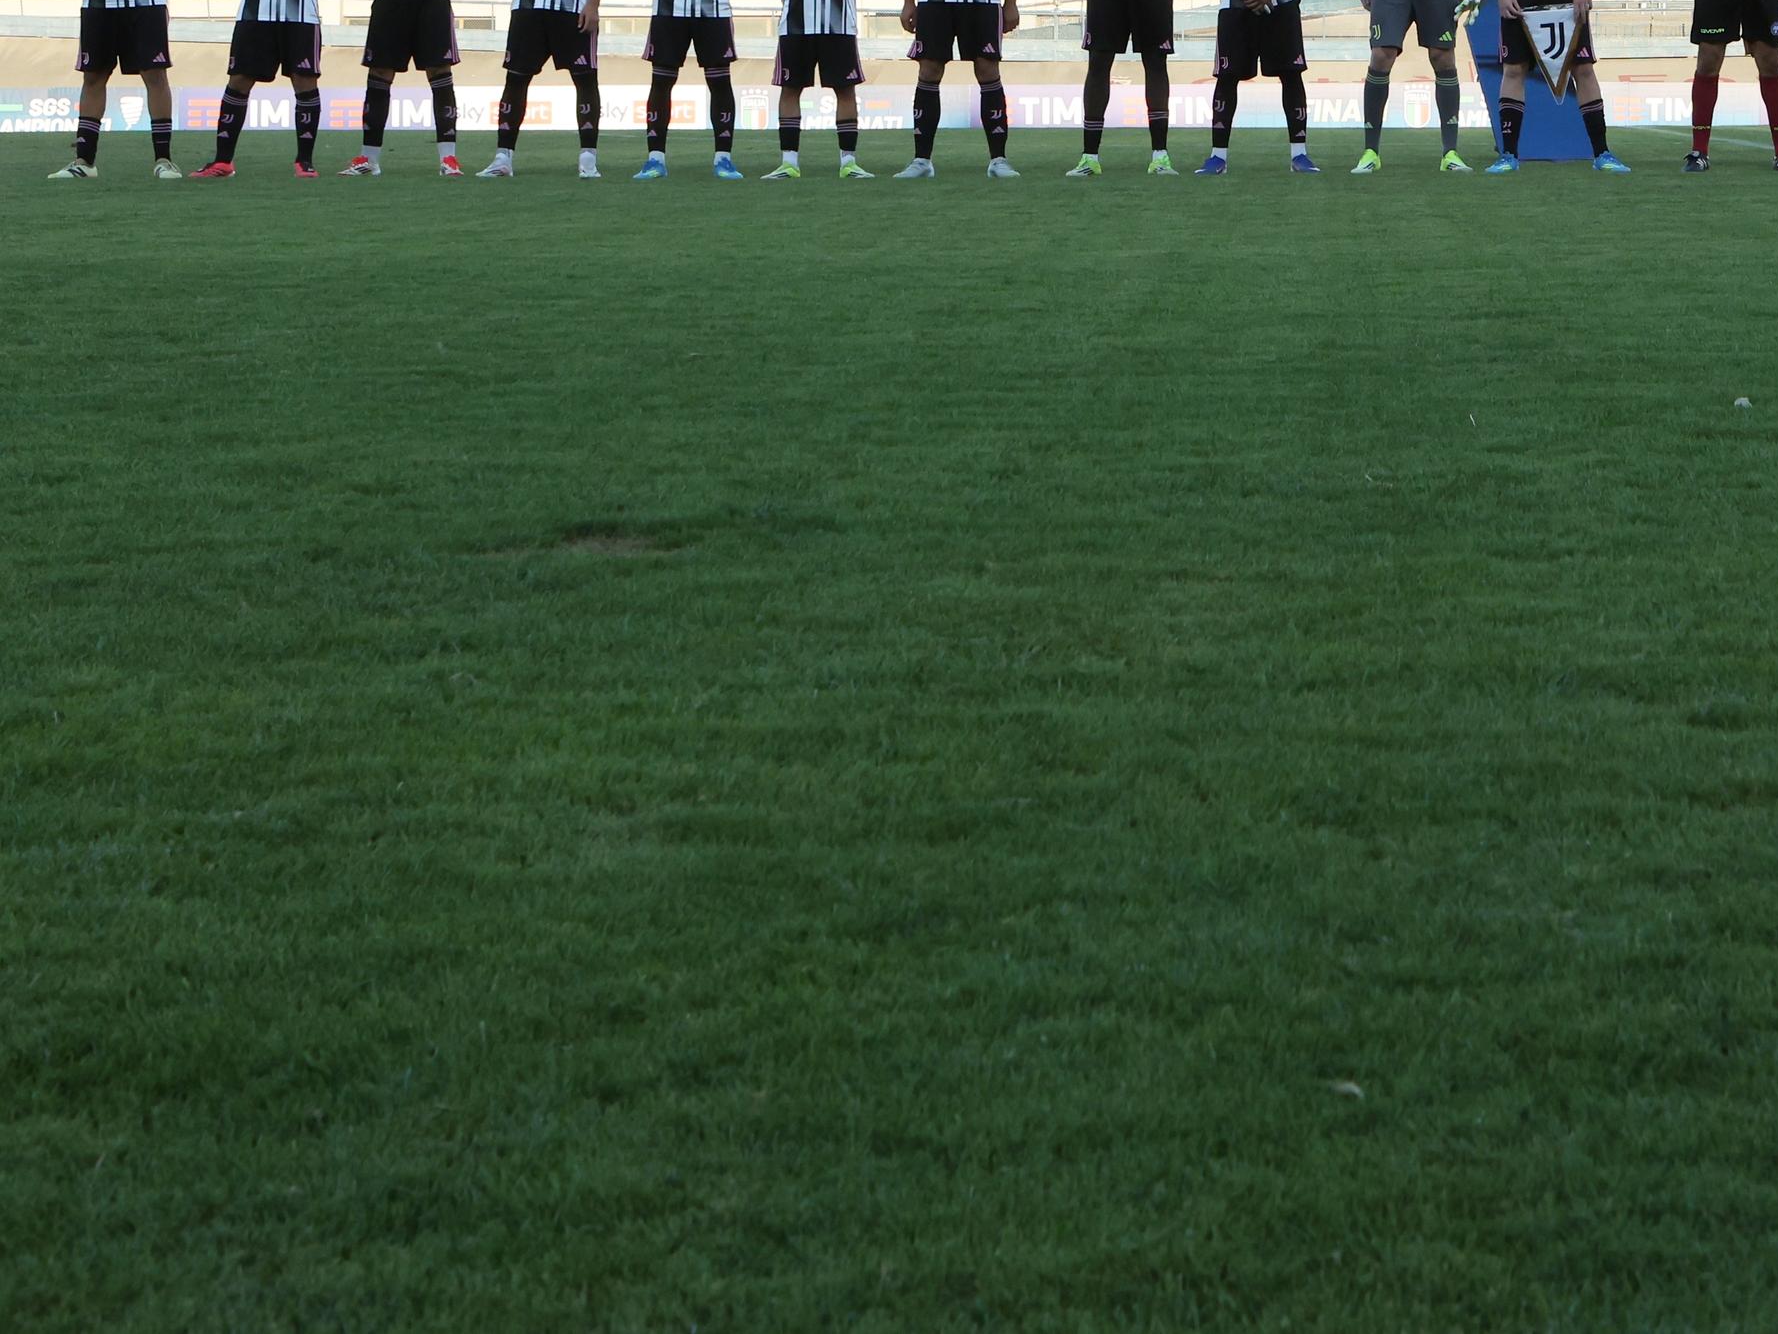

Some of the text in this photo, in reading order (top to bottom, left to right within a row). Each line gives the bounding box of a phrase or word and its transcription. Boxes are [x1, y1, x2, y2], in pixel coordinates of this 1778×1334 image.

[28, 97, 71, 117] SGS
[249, 99, 289, 128] IM
[391, 99, 432, 128] IM
[1019, 96, 1082, 125] TIM
